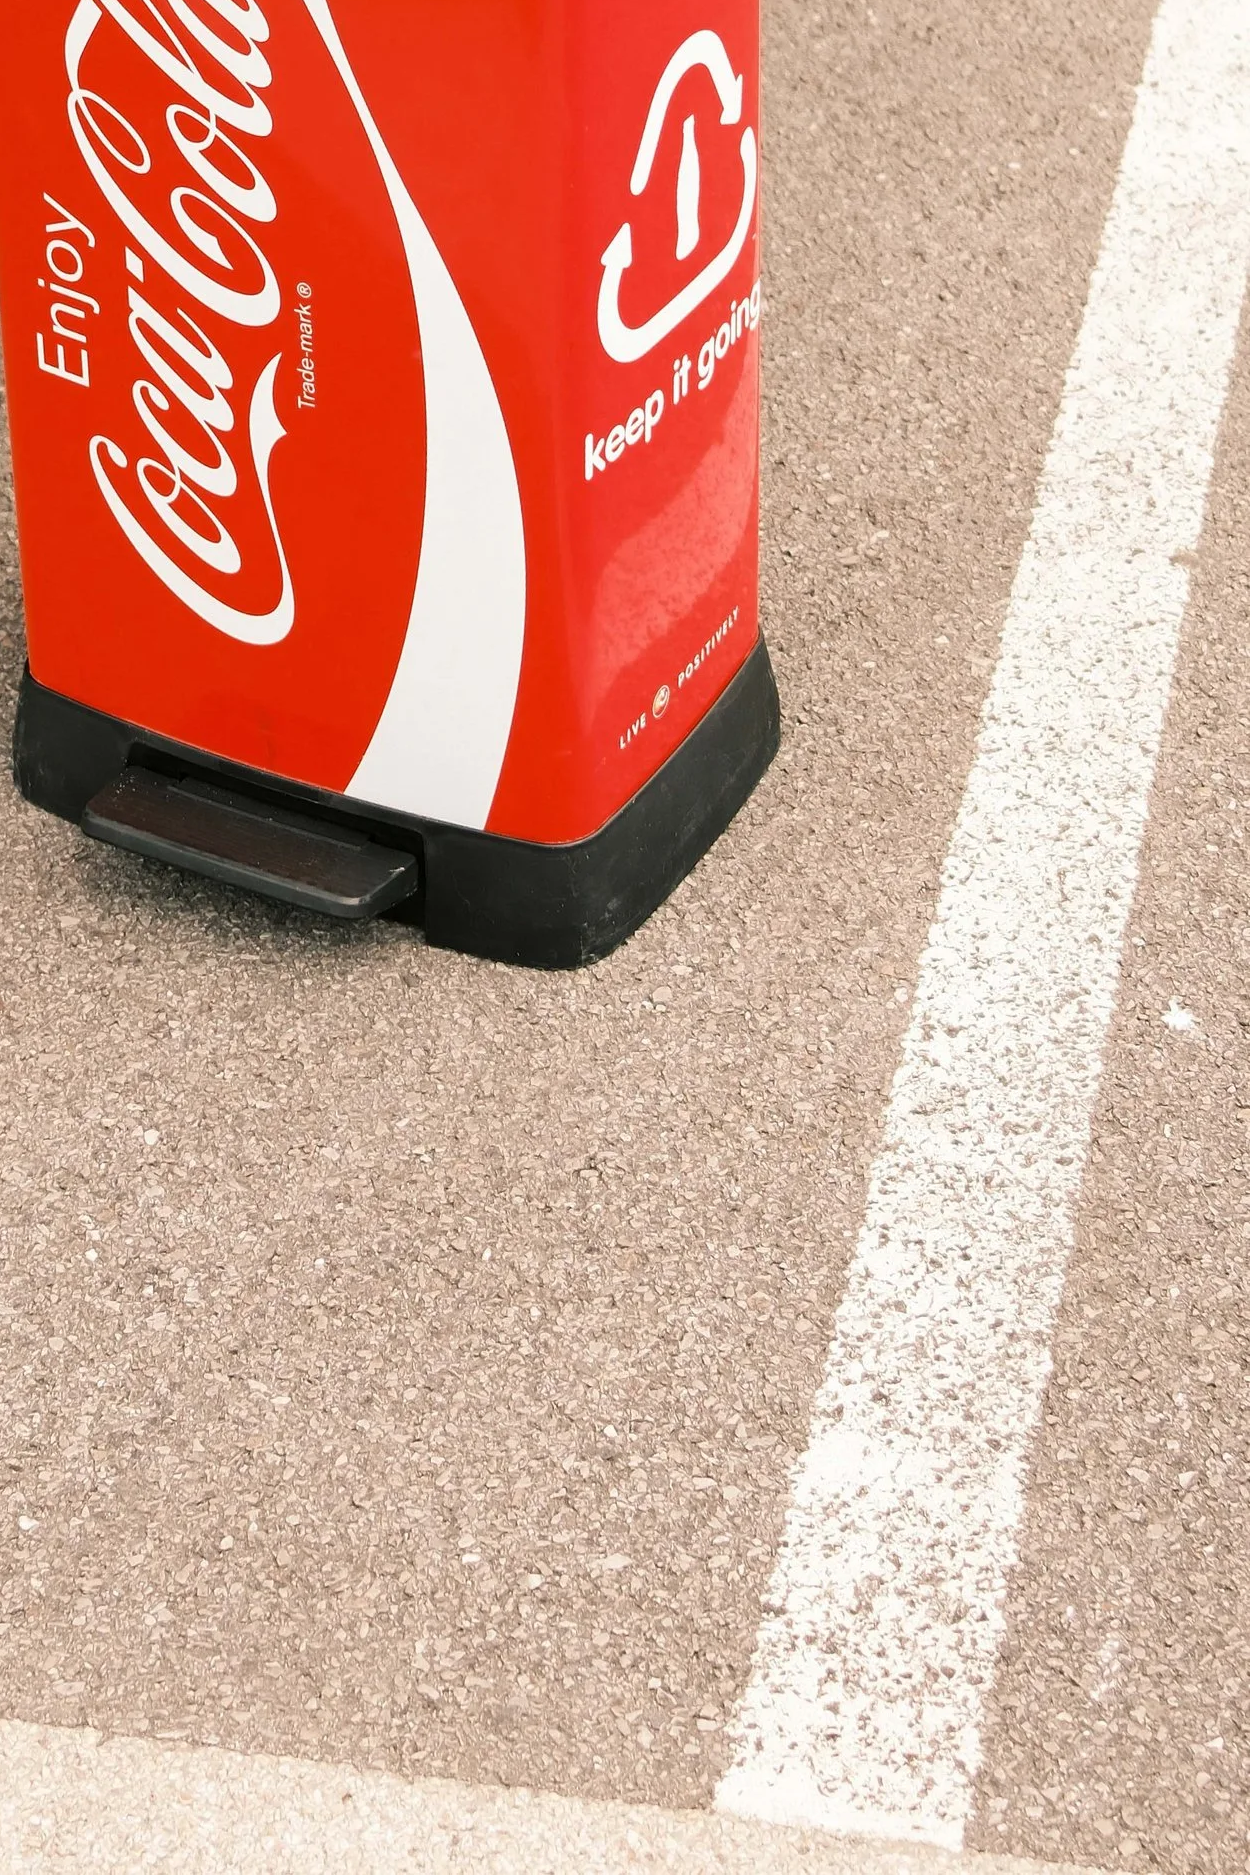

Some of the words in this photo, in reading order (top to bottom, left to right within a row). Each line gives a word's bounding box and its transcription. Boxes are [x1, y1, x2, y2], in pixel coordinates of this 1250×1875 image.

[36, 192, 99, 387] Enjoy
[293, 303, 316, 409] Trade-mark
[584, 388, 664, 481] keep
[672, 354, 692, 406] it
[697, 277, 762, 391] going
[618, 712, 647, 750] LIVE
[676, 605, 740, 689] POSITIVELY
